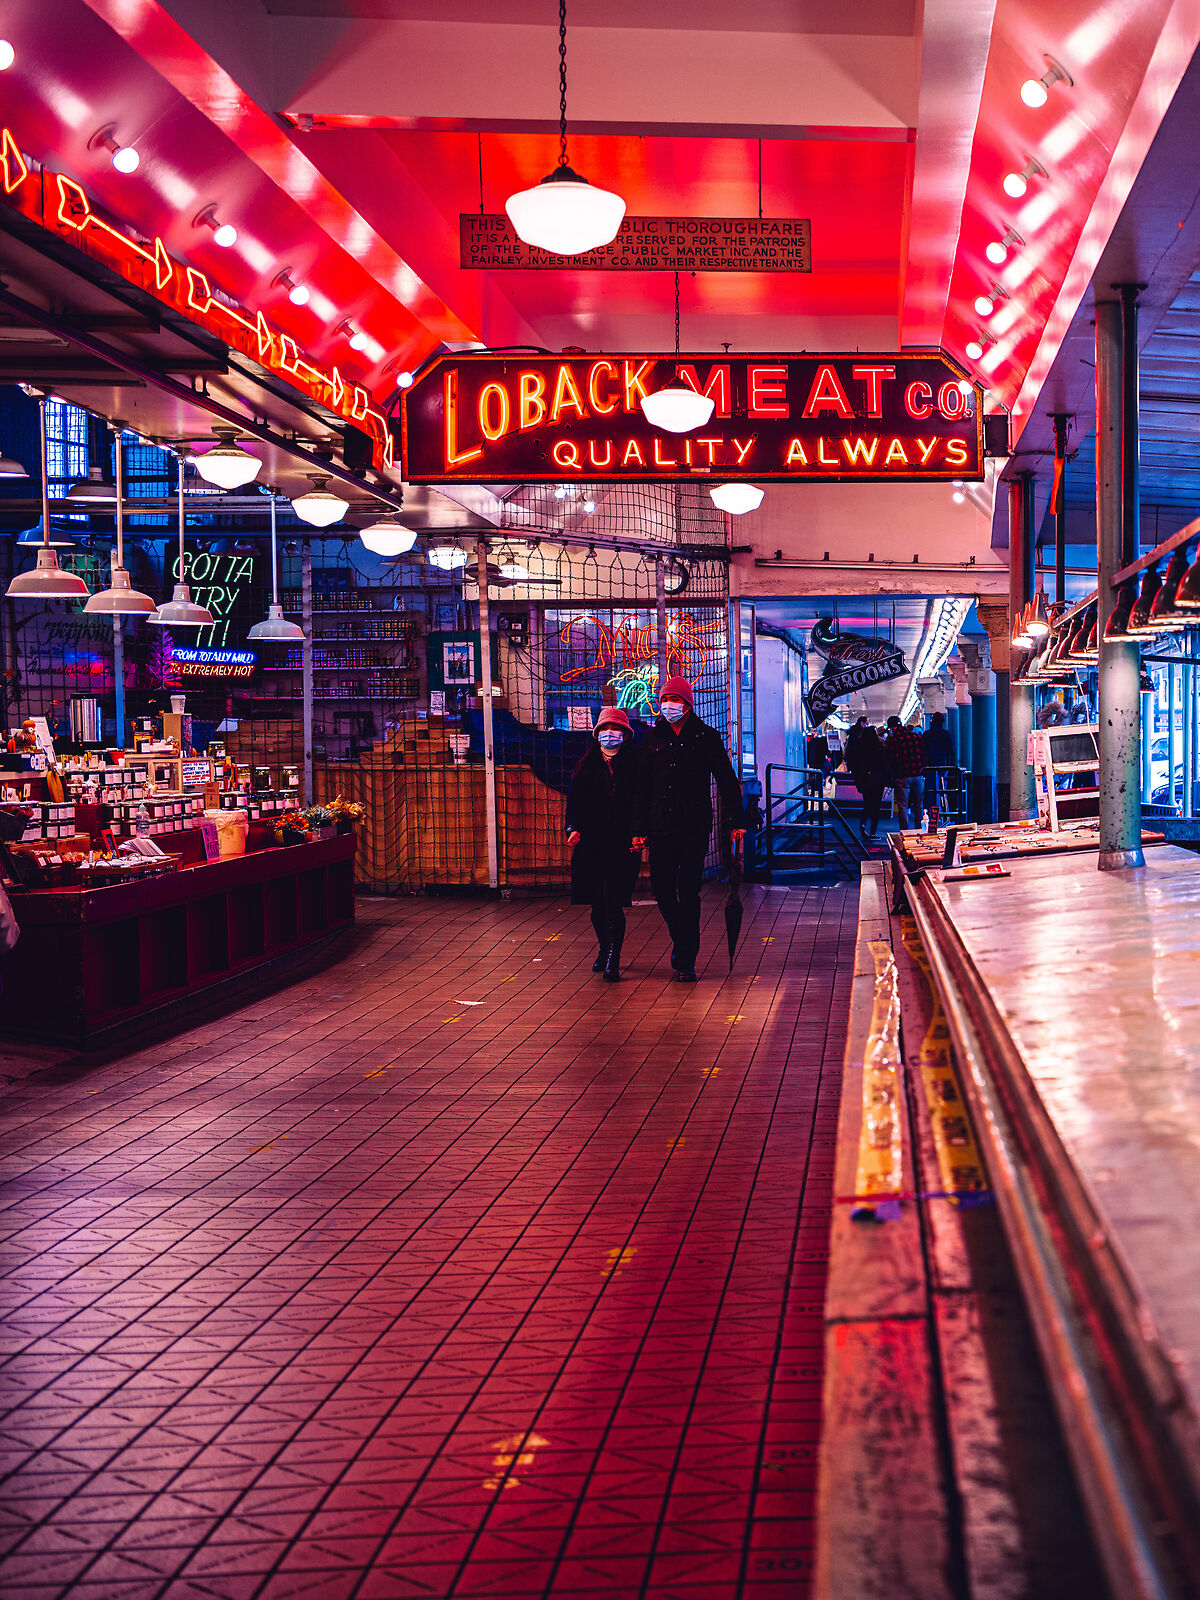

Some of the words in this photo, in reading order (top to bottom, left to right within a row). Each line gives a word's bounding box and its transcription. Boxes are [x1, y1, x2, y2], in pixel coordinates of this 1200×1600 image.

[467, 218, 506, 231] THIS
[621, 221, 658, 233] BLIC
[665, 221, 803, 235] THOROUGHFARE
[471, 233, 482, 243] IT
[486, 234, 498, 243] IS
[502, 234, 511, 243] A
[692, 236, 718, 246] FOR
[723, 236, 746, 246] THE
[750, 237, 806, 247] PATRONS
[470, 244, 488, 254] OF
[495, 245, 521, 254] THE
[622, 246, 670, 256] PUBLIC
[676, 247, 726, 257] MARKET
[753, 248, 777, 257] AND
[780, 248, 802, 258] THE
[471, 255, 523, 265] FAIRLEY
[528, 256, 606, 266] INVESTMENT
[611, 256, 631, 266] CO.
[635, 257, 658, 267] AND
[662, 257, 696, 267] THEIR
[699, 258, 758, 268] RESPECTIVE
[760, 258, 805, 269] TENANTS
[444, 360, 657, 473] LOBACK
[675, 364, 897, 419] MEAT
[553, 437, 755, 469] QUALITY
[784, 436, 968, 466] ALWAYS
[172, 551, 254, 584] GOTTA
[191, 585, 240, 616] TRY
[170, 649, 198, 661] FROM
[198, 651, 232, 662] TOTALLY
[231, 652, 254, 664] MILD
[182, 663, 233, 676] EXTREMELY
[233, 665, 254, 677] HOT
[811, 658, 902, 713] RESTROOMS
